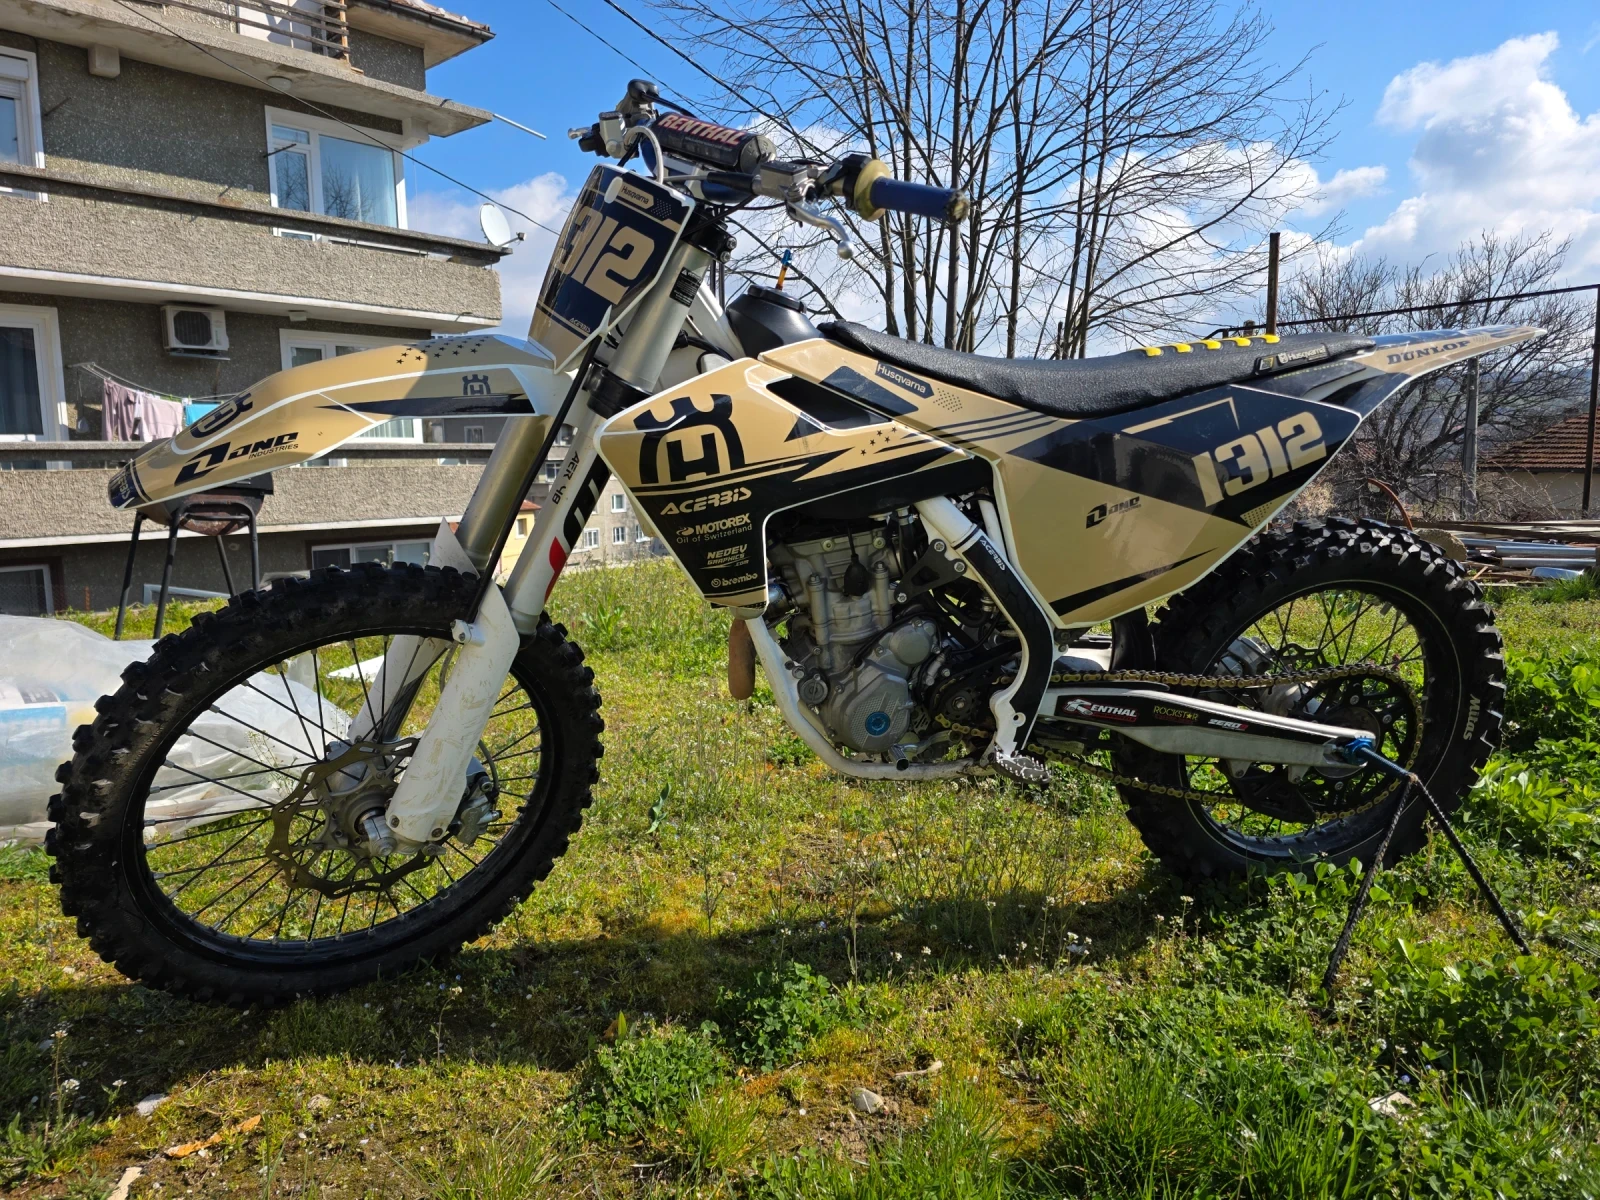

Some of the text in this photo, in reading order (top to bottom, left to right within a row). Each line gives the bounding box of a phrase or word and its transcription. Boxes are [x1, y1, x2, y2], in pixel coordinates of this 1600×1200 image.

[658, 114, 744, 145] RENTHAL
[621, 186, 650, 205] Husqvarna
[553, 206, 655, 305] 312
[1386, 340, 1471, 364] DUNLOP
[877, 363, 927, 393] Husqvarna
[248, 443, 299, 460] INDUSTRIES
[1191, 411, 1327, 507] 1312
[564, 451, 581, 481] AER
[660, 487, 752, 515] ACERBIS
[676, 523, 753, 544] Oil of Switzerland
[695, 513, 751, 535] MOTOREX
[707, 544, 748, 559] NEDEV
[980, 539, 1005, 571] ACERBIS
[721, 572, 758, 586] brembo
